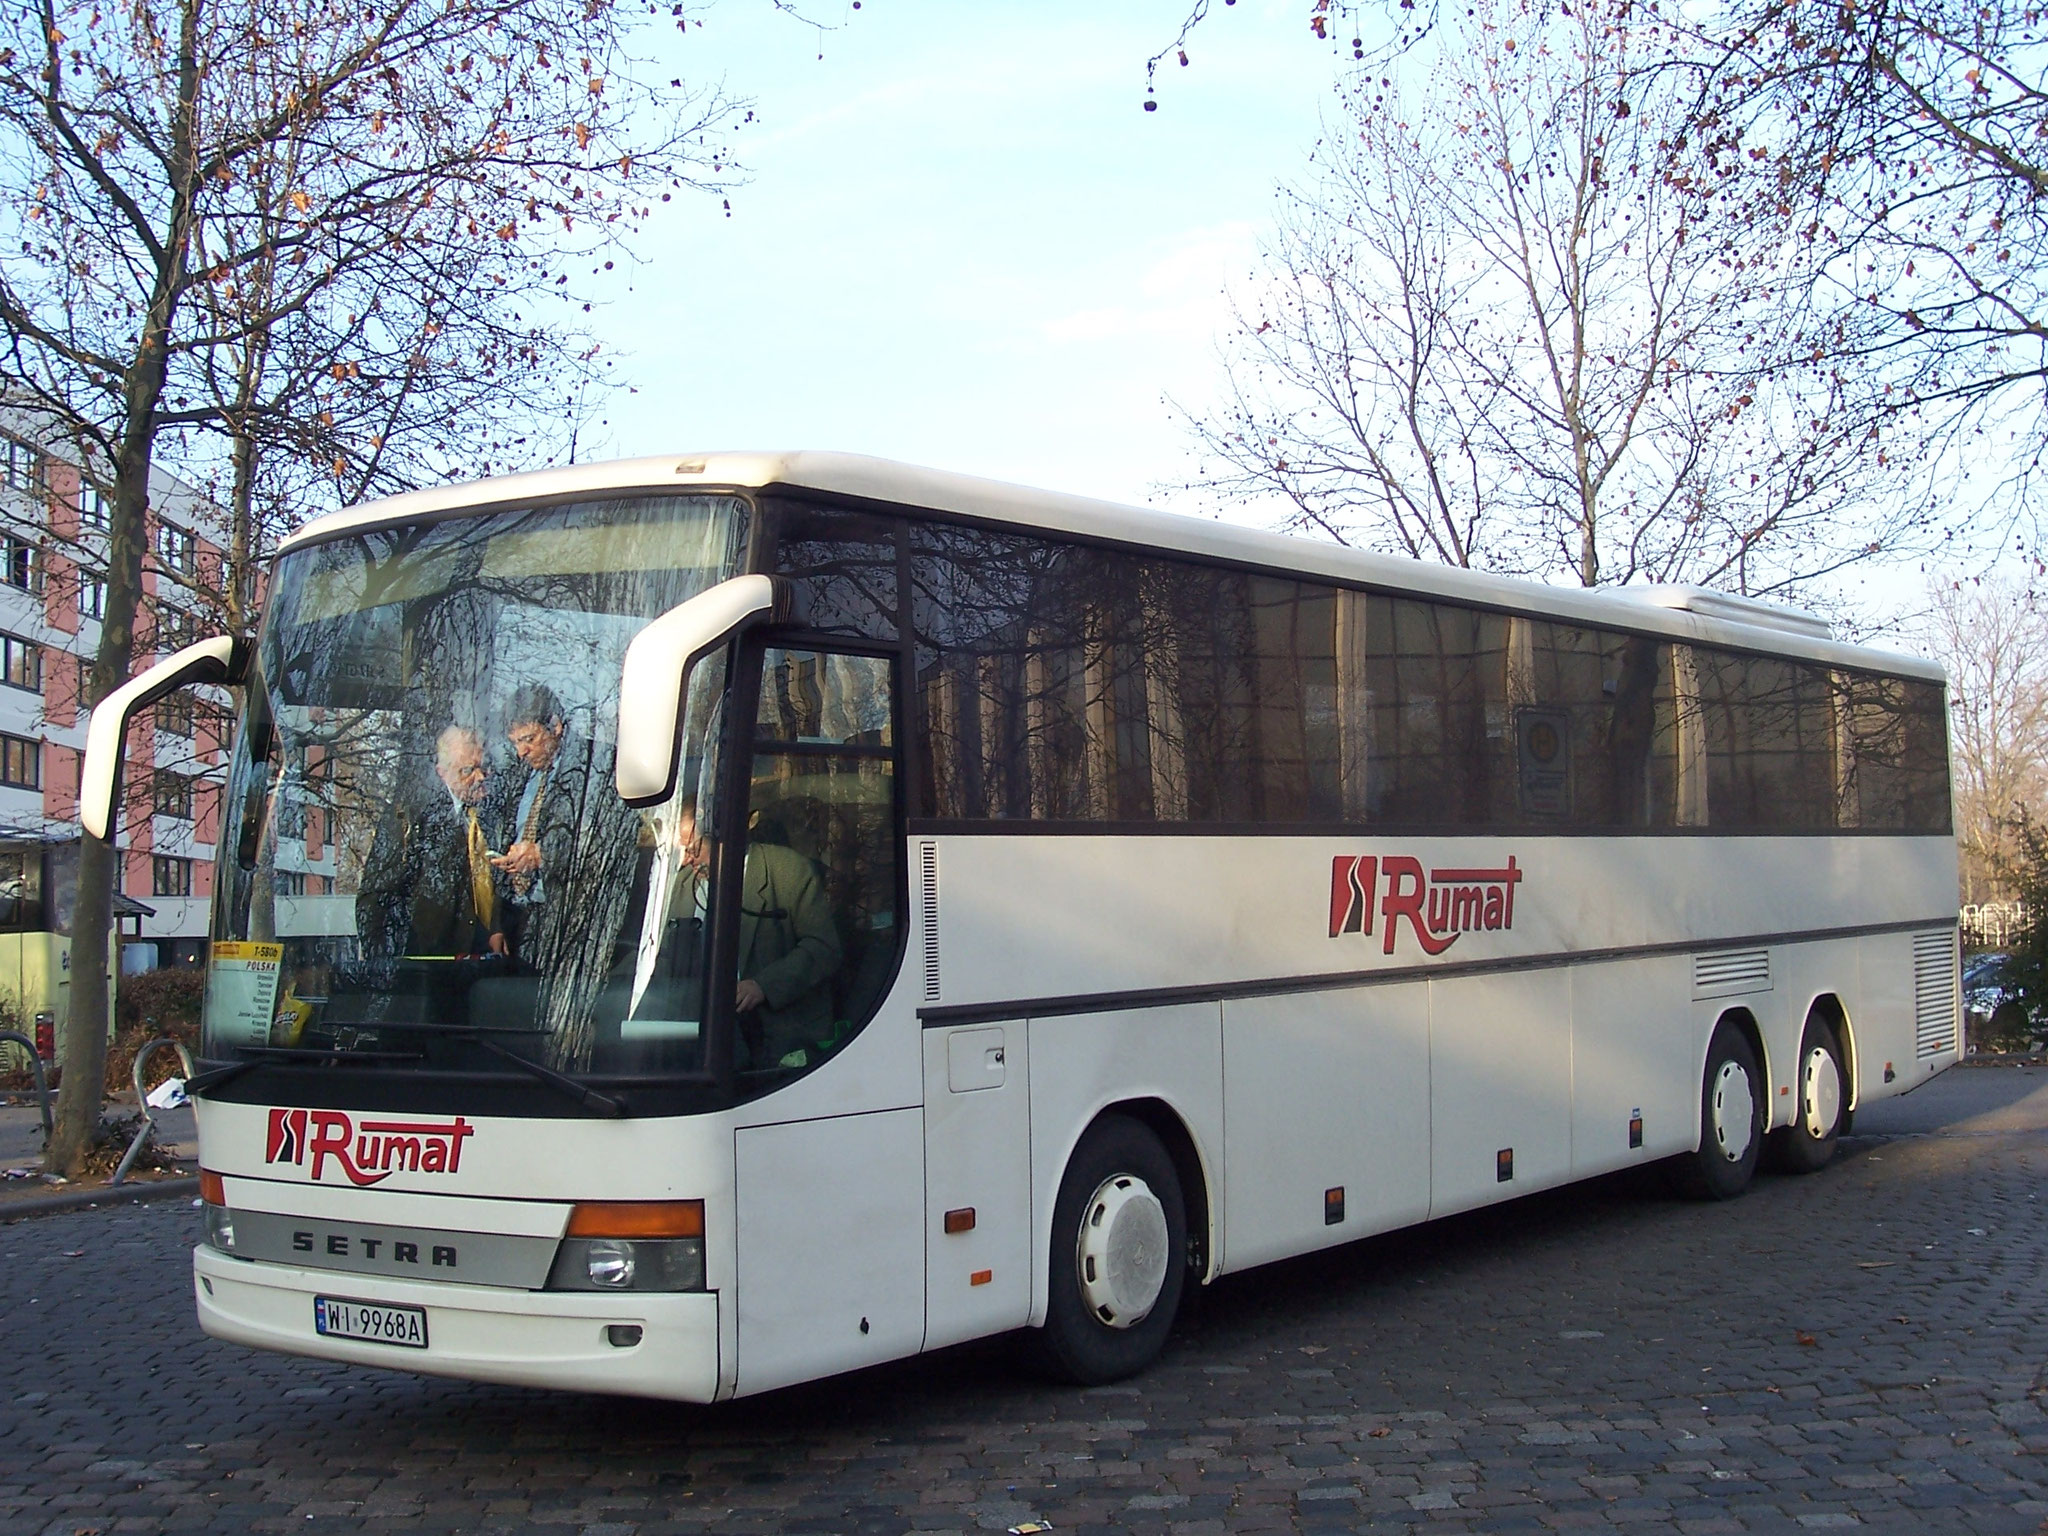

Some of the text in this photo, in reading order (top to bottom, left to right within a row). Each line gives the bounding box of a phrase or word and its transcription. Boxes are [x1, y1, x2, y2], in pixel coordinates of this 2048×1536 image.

[1381, 855, 1523, 956] Rumat
[246, 961, 276, 971] POLSKA
[309, 1109, 474, 1186] Rumat
[292, 1231, 457, 1267] SETRA
[328, 1304, 420, 1342] WI 9968A
